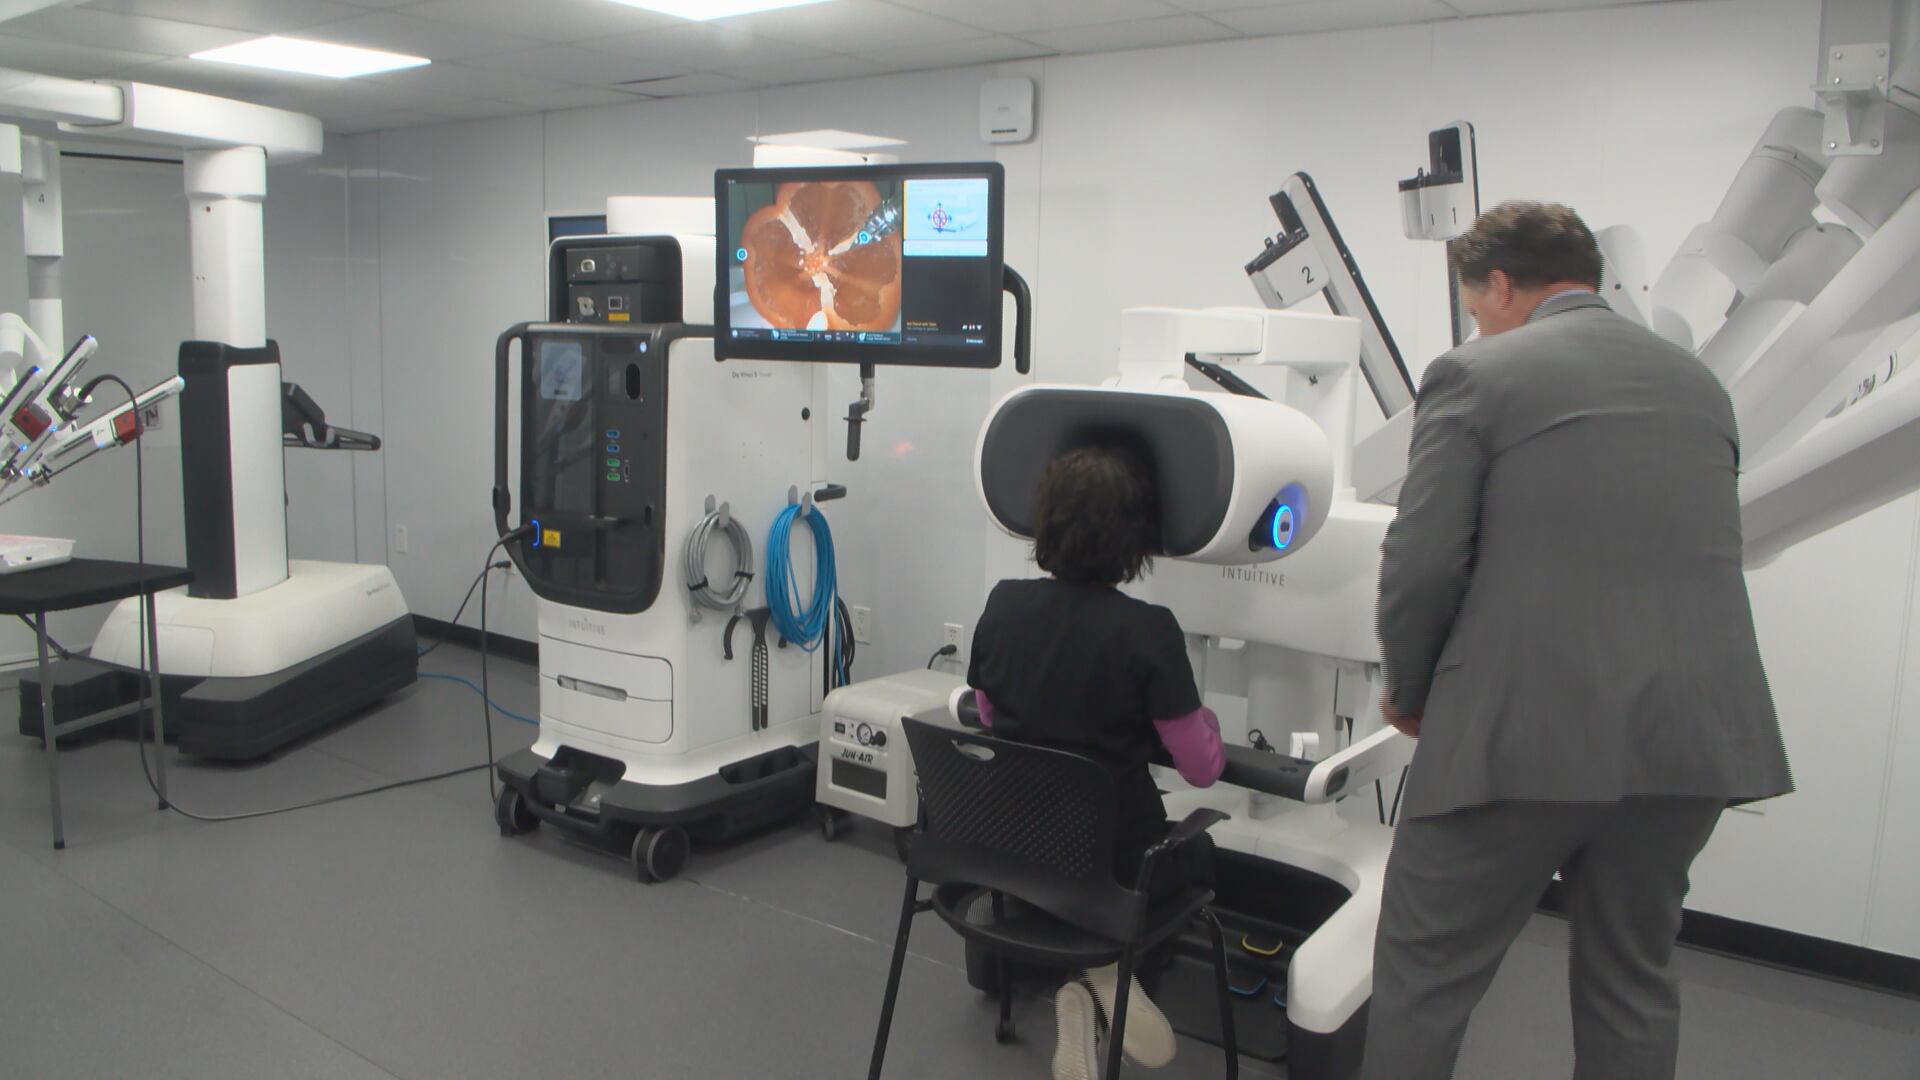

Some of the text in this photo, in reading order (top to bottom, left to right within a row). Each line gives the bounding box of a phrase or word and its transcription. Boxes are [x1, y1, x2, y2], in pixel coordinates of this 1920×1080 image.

[38, 193, 45, 204] 4
[1452, 207, 1457, 225] 1
[1301, 266, 1315, 284] 2
[1222, 566, 1287, 587] INTUITIVE
